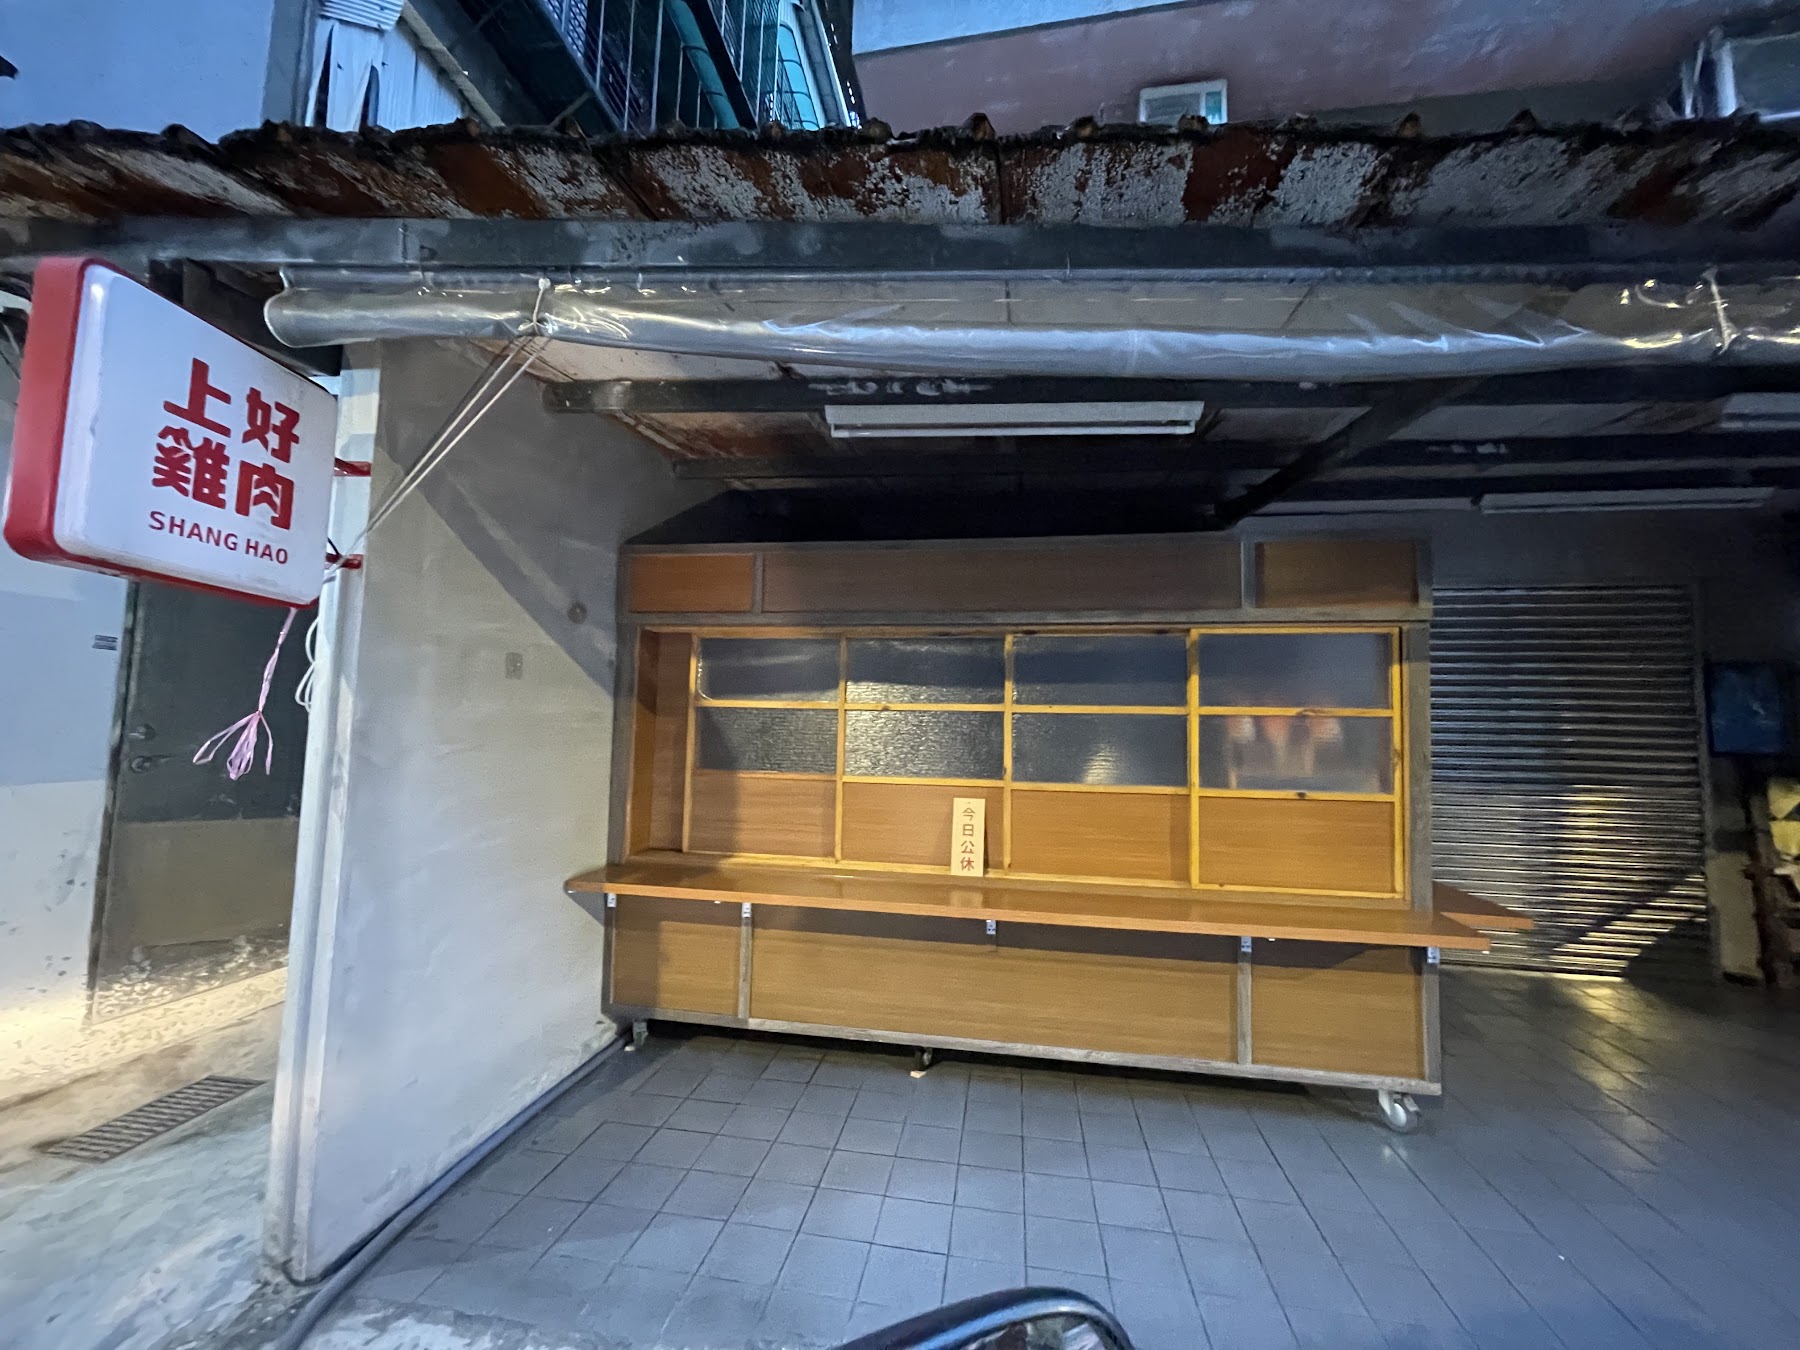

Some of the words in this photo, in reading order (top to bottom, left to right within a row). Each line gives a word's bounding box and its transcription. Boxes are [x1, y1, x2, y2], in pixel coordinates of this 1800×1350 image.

[163, 357, 300, 463] 上好
[152, 425, 294, 530] 雞肉
[148, 510, 238, 551] SHANG
[245, 538, 288, 564] HAO
[960, 807, 976, 871] 今日公休
